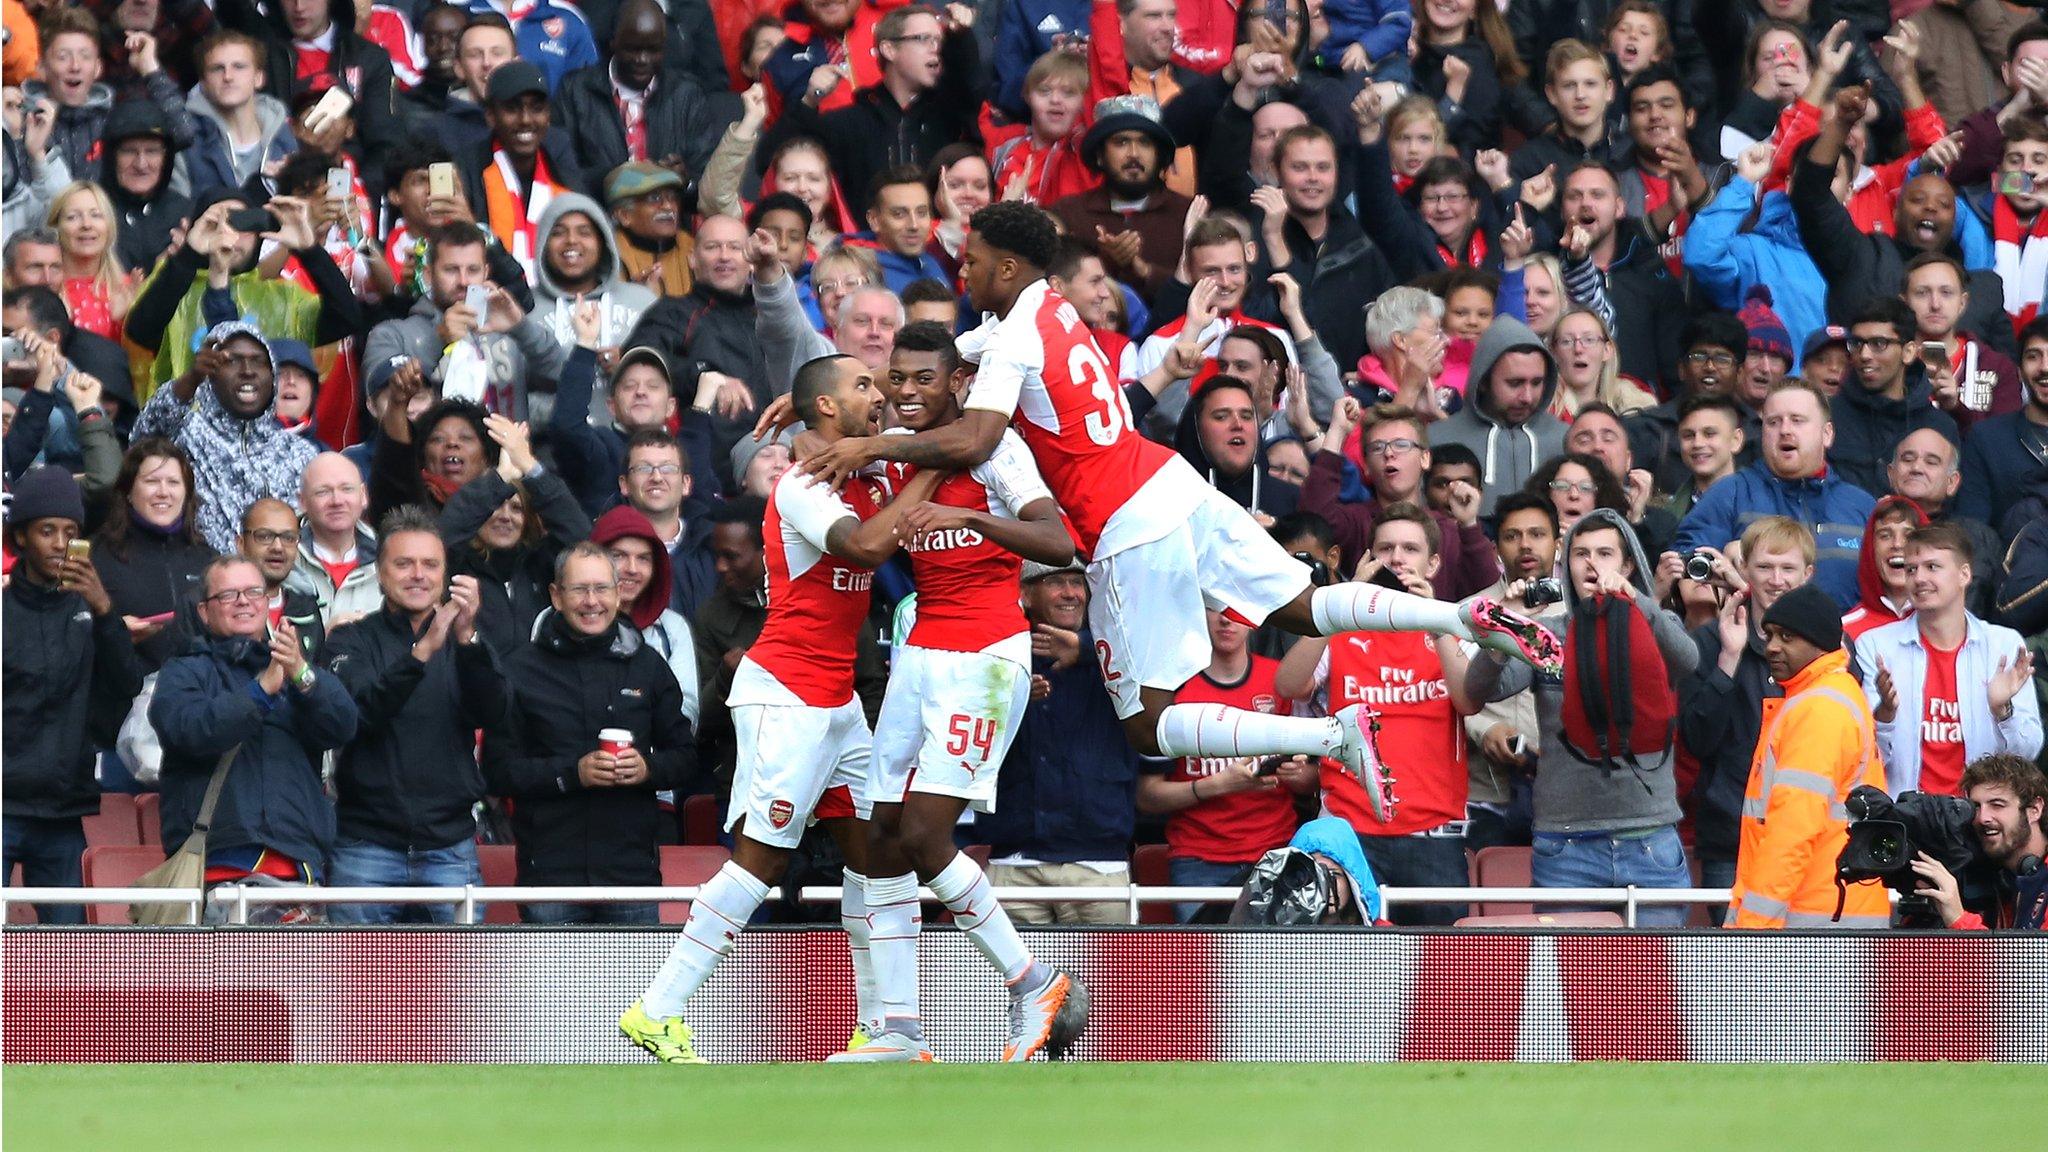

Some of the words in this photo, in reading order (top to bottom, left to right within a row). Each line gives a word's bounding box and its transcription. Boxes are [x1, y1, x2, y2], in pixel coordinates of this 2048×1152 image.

[1380, 666, 1415, 683] Fly
[1344, 675, 1449, 703] Emirates
[1929, 697, 1959, 719] Fly
[946, 713, 996, 762] 54
